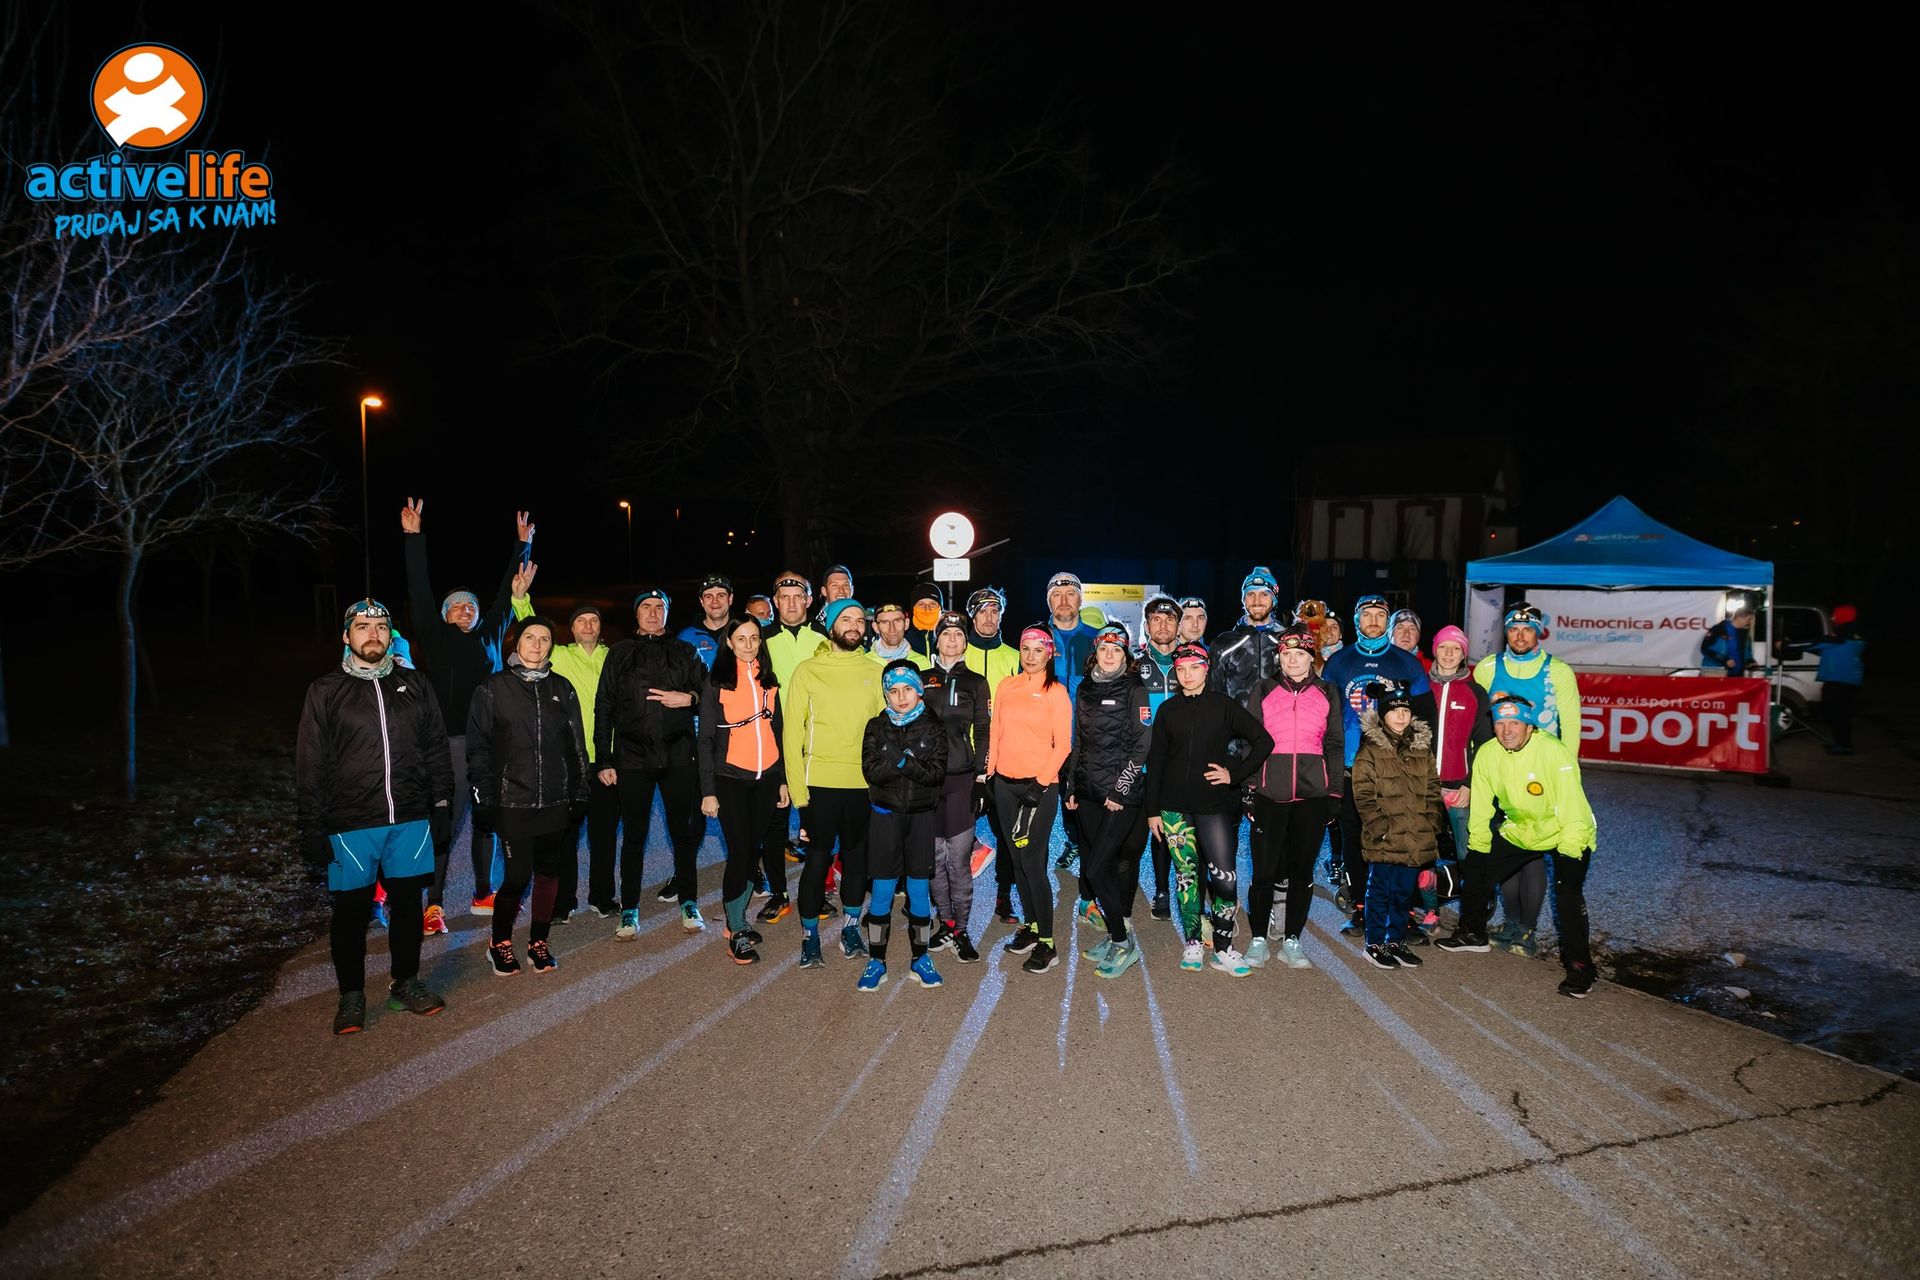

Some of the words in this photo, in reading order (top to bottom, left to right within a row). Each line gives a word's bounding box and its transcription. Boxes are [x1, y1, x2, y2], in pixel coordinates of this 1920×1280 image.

[1556, 615, 1654, 630] Nemocnica
[1659, 617, 1712, 630] AGEL
[1114, 760, 1142, 796] SVK
